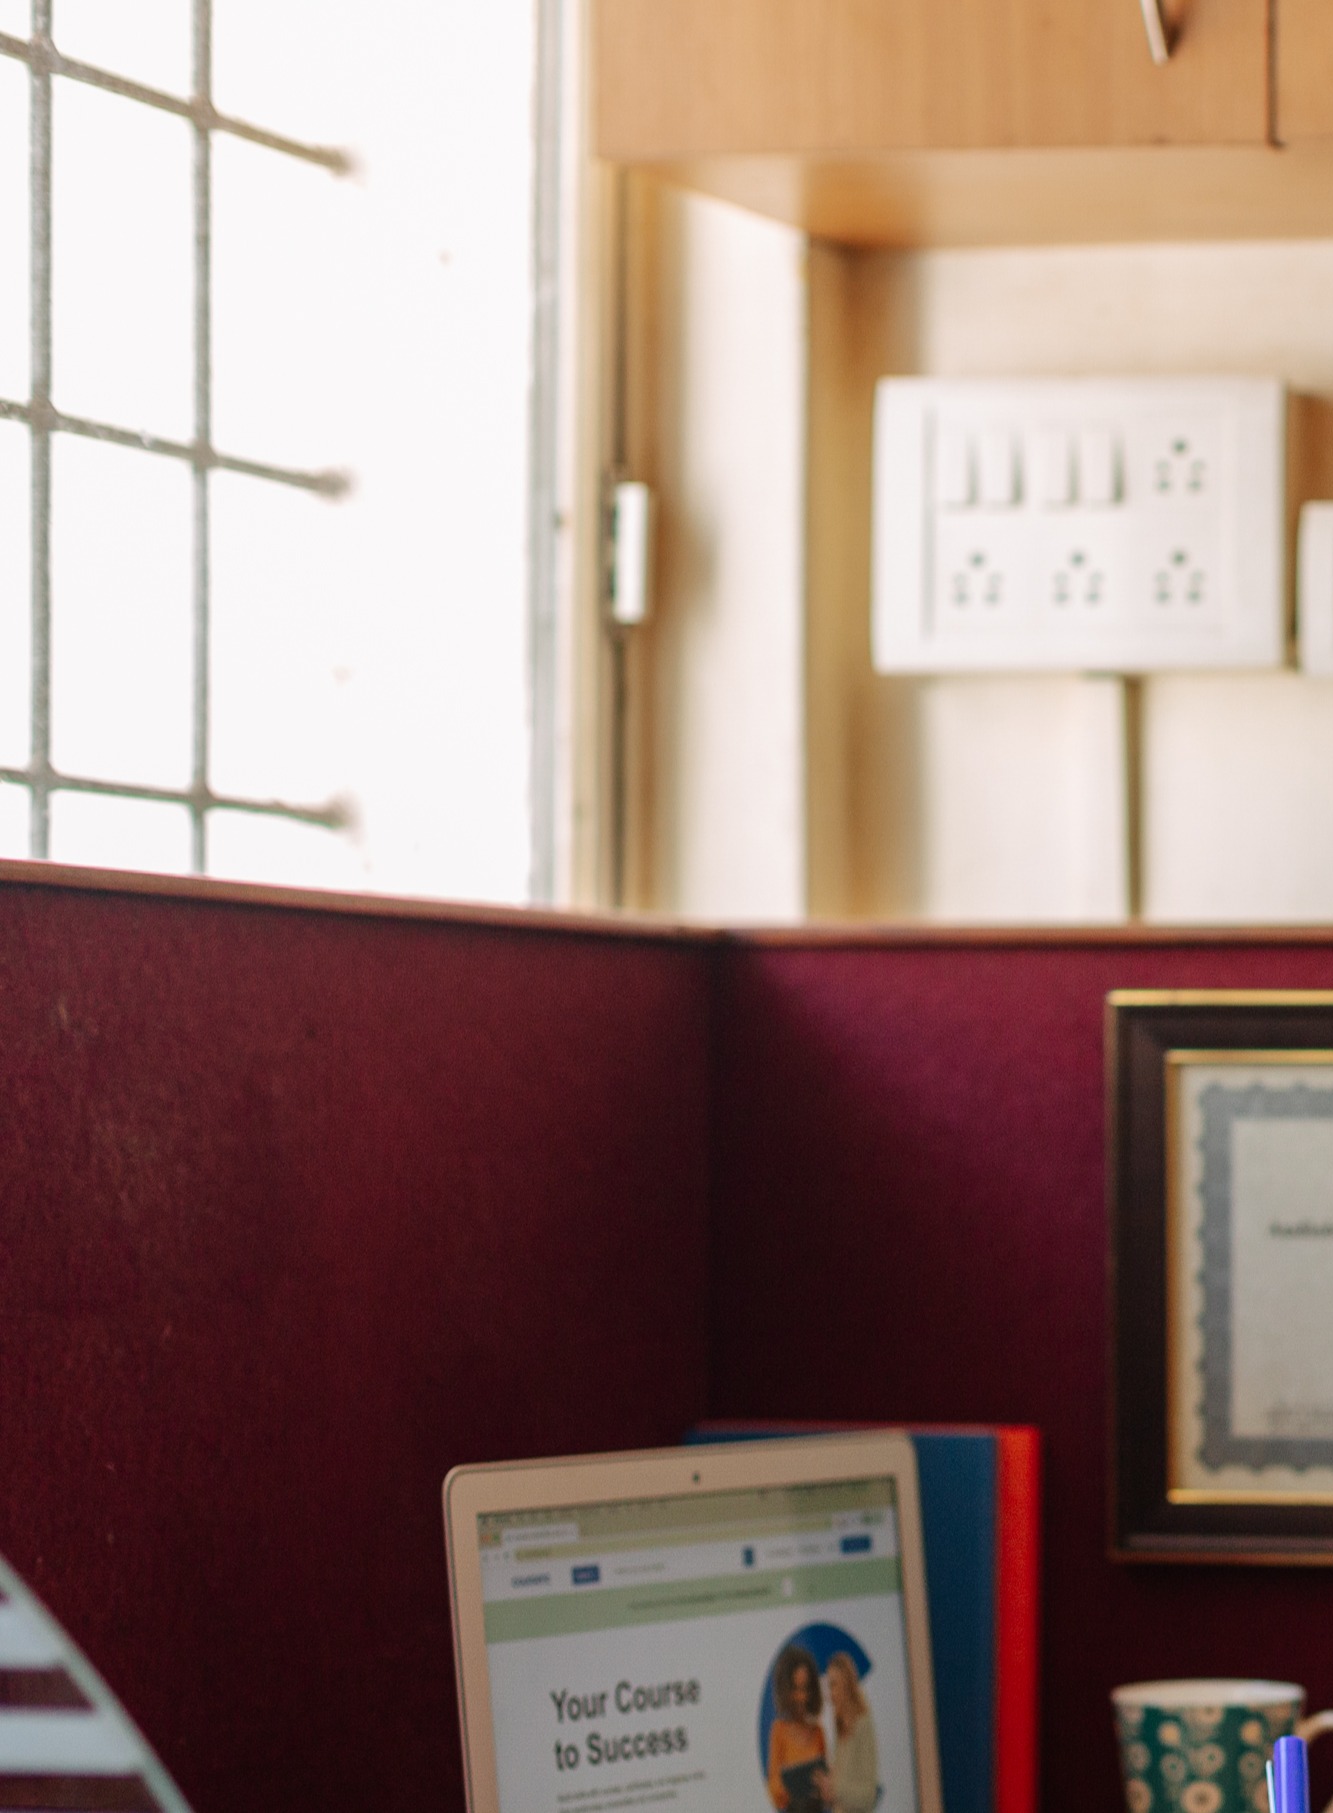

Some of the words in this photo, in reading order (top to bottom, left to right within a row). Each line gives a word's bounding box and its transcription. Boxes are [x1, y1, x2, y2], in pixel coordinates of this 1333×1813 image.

[550, 1687, 607, 1724] Your
[614, 1678, 700, 1714] Course
[554, 1738, 580, 1771] to
[585, 1724, 689, 1767] Success
